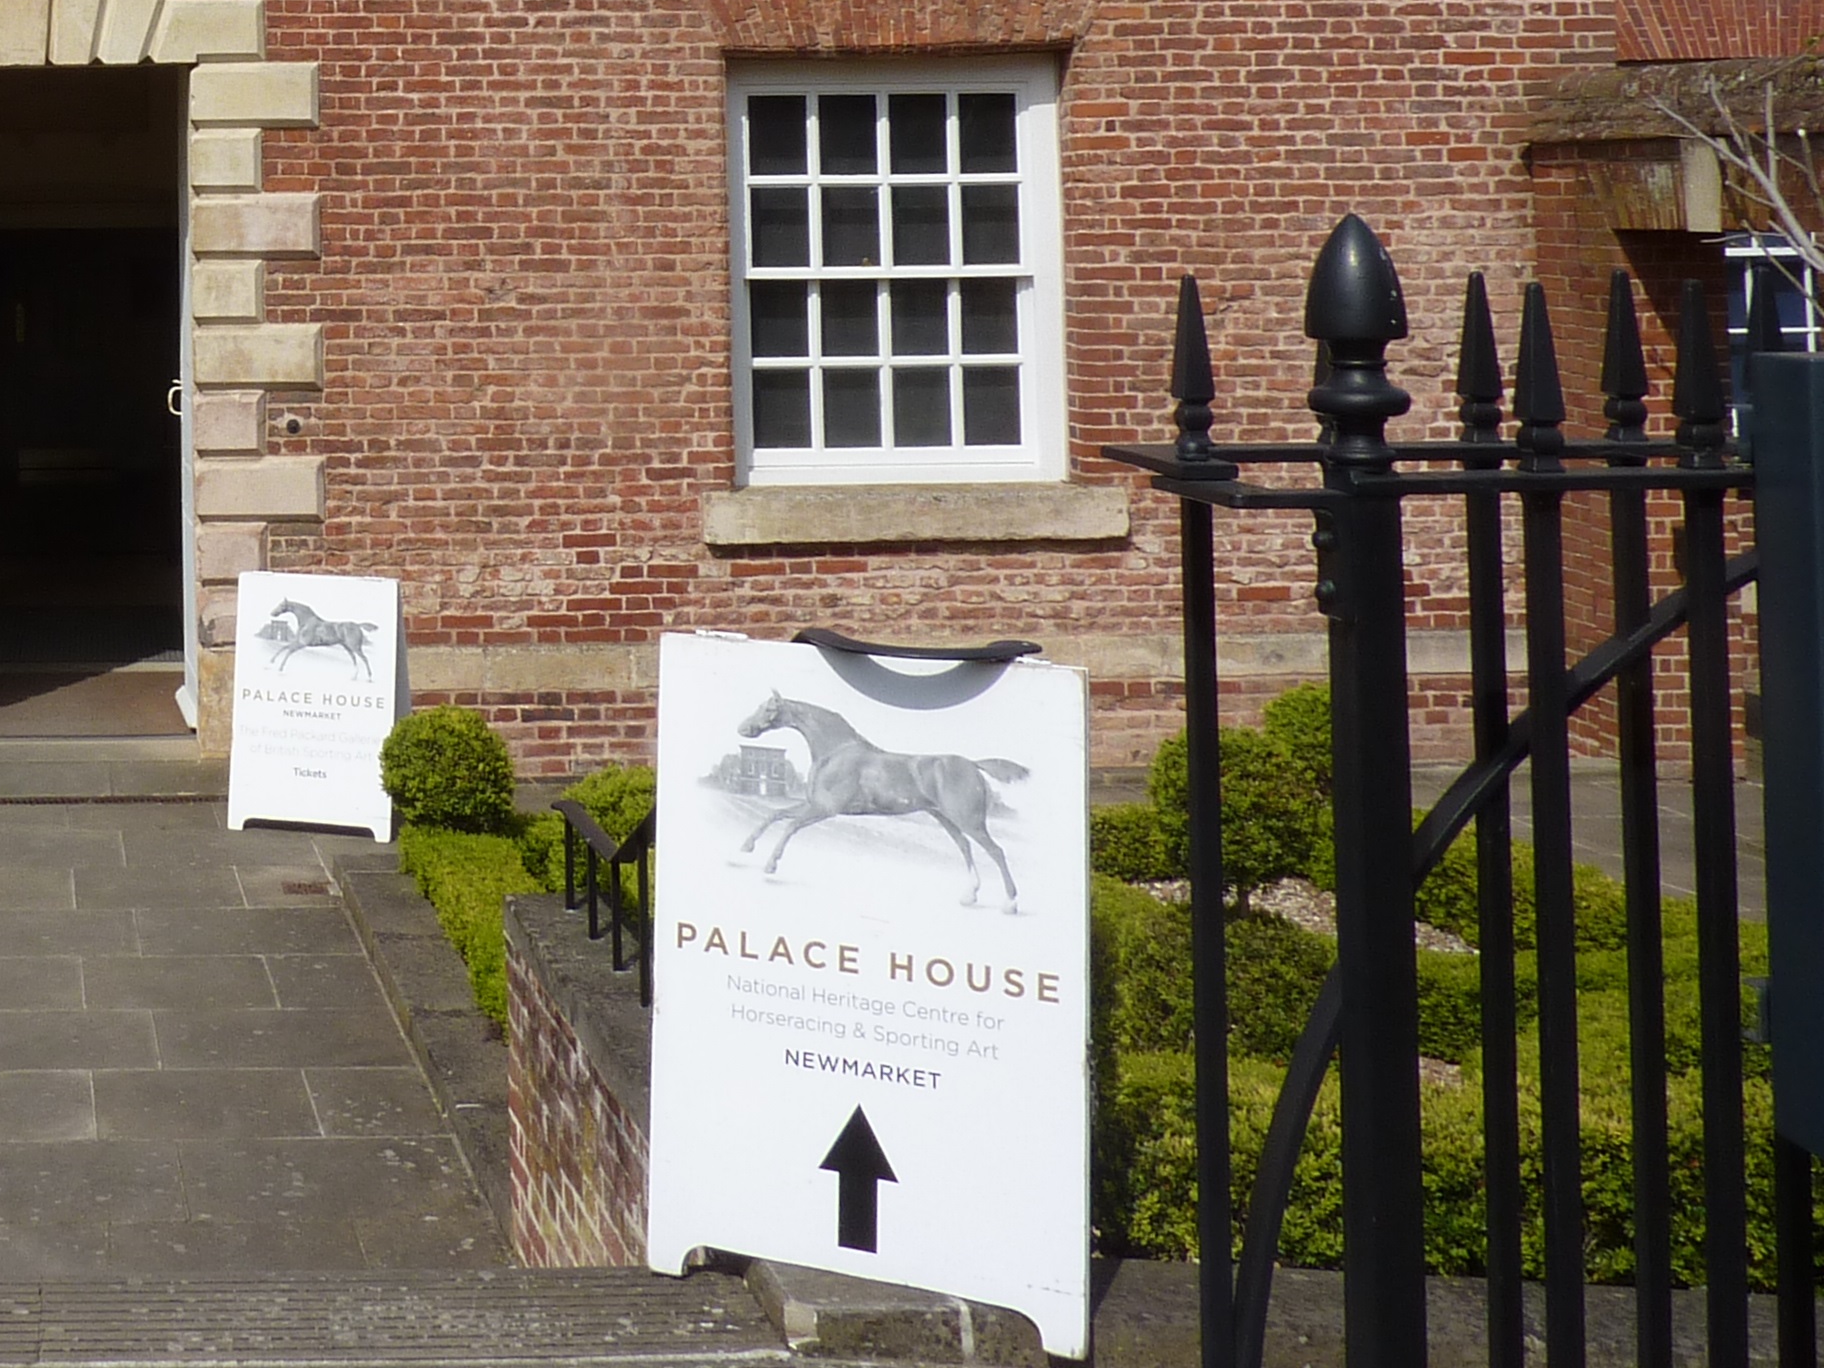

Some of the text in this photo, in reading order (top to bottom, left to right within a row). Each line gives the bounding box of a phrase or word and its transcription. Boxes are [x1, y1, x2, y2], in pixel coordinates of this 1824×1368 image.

[242, 688, 385, 709] PALACE HOUSE
[283, 709, 341, 720] NEWMARKET
[293, 766, 327, 779] Tickets
[676, 921, 1060, 1004] PALACE HOUSE
[727, 974, 1005, 1032] National Heritage Centre for
[731, 1003, 999, 1060] Horseracing & Sporting Art
[784, 1048, 941, 1090] NEWMARKET
